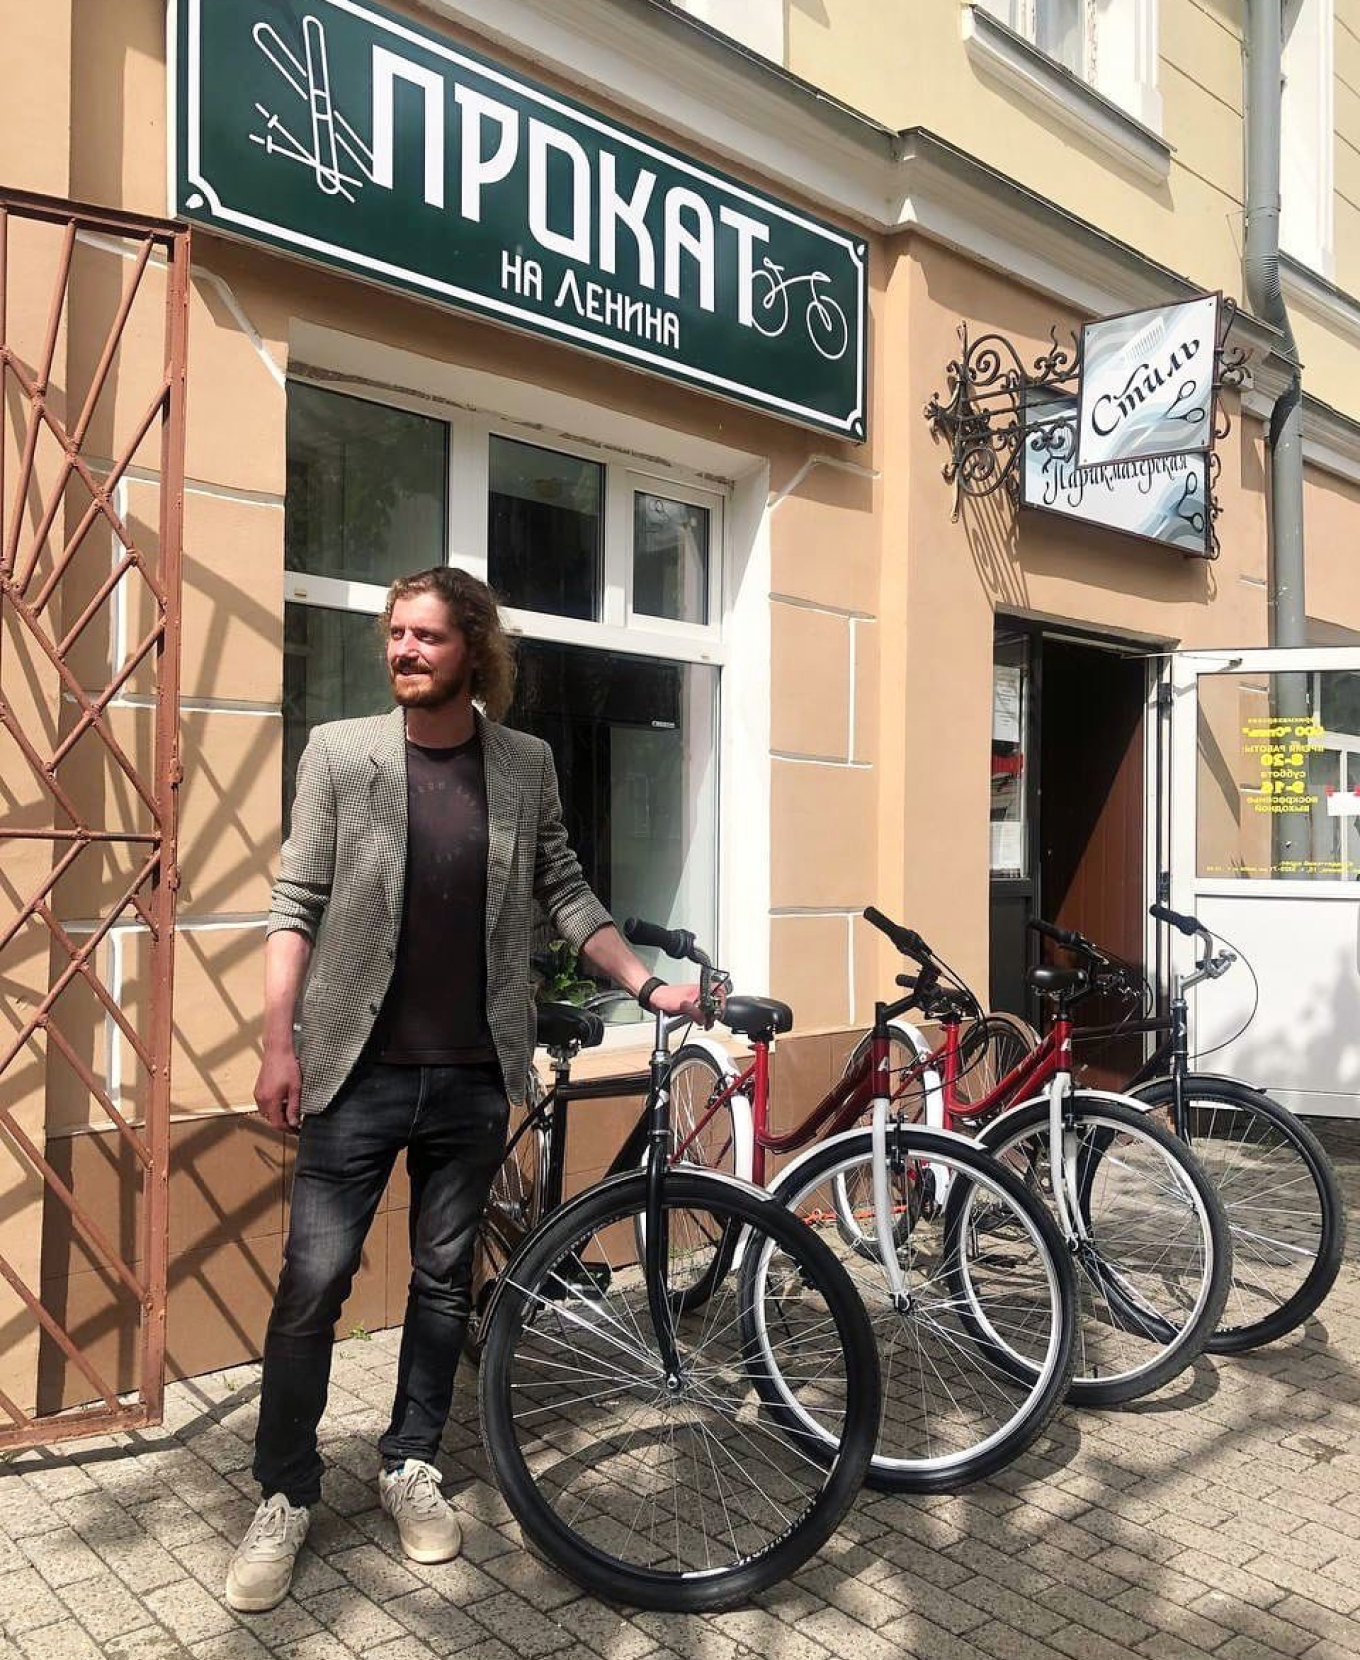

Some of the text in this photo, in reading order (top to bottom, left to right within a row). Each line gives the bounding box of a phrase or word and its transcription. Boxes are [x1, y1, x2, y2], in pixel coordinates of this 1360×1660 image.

[372, 44, 768, 327] ПРОКАТ
[502, 250, 680, 349] НА ЛЕНИНА
[1091, 338, 1200, 437] Стиль
[1042, 454, 1188, 507] Парикмахерская
